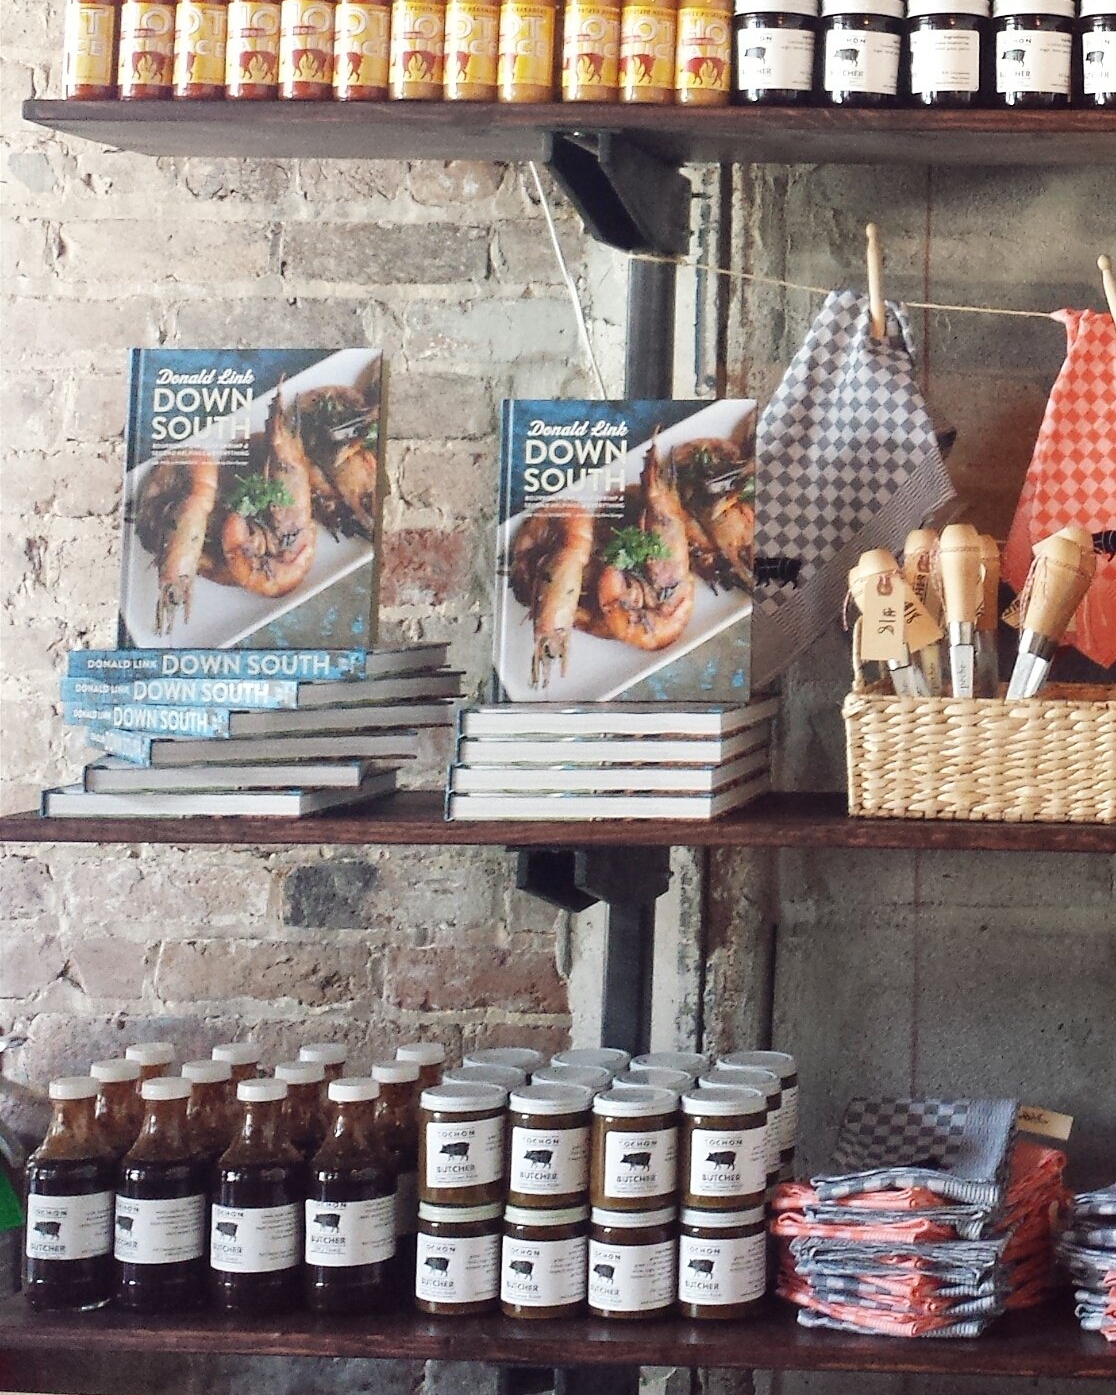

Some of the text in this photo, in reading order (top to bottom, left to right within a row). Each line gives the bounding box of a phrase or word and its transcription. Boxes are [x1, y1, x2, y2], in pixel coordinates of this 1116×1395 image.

[156, 368, 255, 385] Donald Link
[153, 388, 253, 412] DOWN
[152, 416, 250, 440] SOUTH
[527, 419, 629, 437] Donald Link
[525, 439, 628, 464] DOWN
[524, 468, 625, 493] SOUTH
[87, 654, 330, 674] DONALD LINK DOWN SOUTH
[75, 681, 269, 704] DONALD LINK DOWN SOUTH
[113, 706, 155, 728] DOWN
[160, 711, 208, 730] SOUTH
[437, 1164, 475, 1172] BUTCHER
[520, 1172, 558, 1180] BUTCHER
